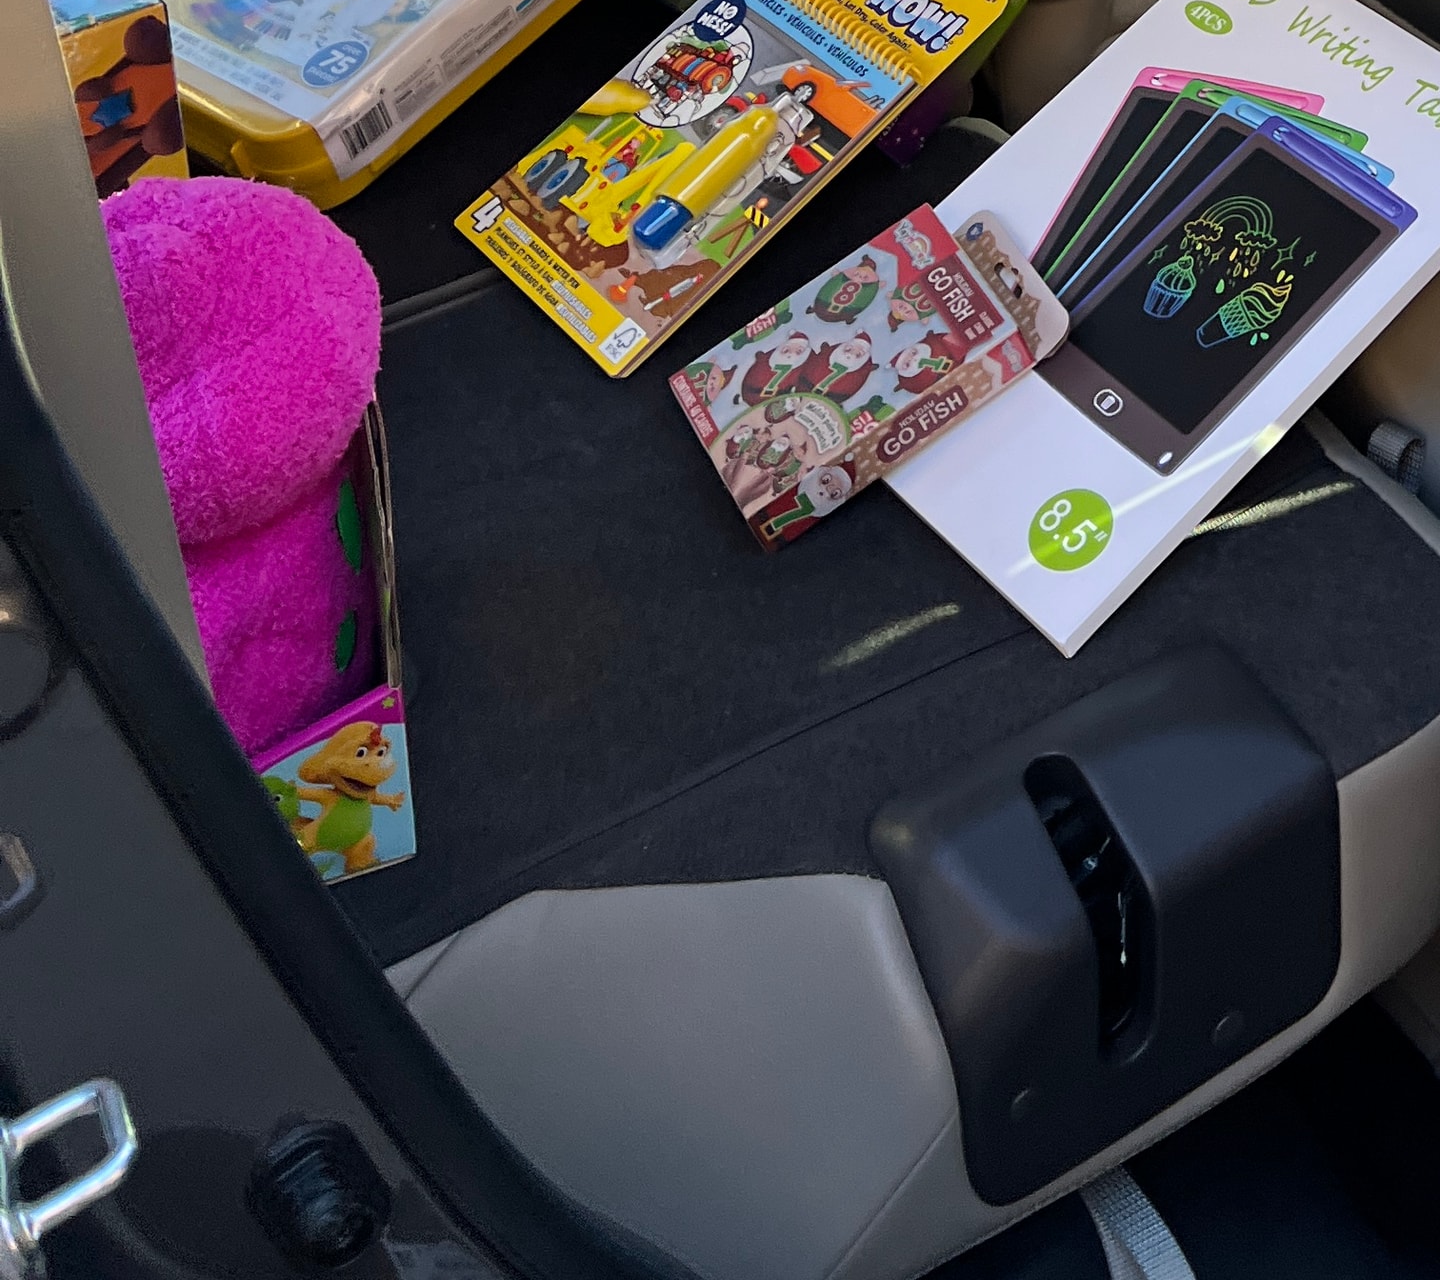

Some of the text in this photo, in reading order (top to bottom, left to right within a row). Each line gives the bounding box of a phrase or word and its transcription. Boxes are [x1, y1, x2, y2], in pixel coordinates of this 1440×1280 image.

[697, 11, 733, 37] MESS!
[713, 0, 739, 21] NO
[1190, 4, 1227, 32] 4PCS
[318, 48, 357, 75] 75
[1287, 5, 1395, 91] Writing
[471, 196, 504, 233] 4
[569, 276, 581, 290] PEN
[927, 267, 976, 323] GO FISH
[953, 272, 974, 299] HOLIDAY
[883, 425, 916, 457] GO
[920, 390, 965, 433] FISH
[898, 398, 936, 429] HOLIDAY
[1039, 499, 1107, 552] 8.5"
